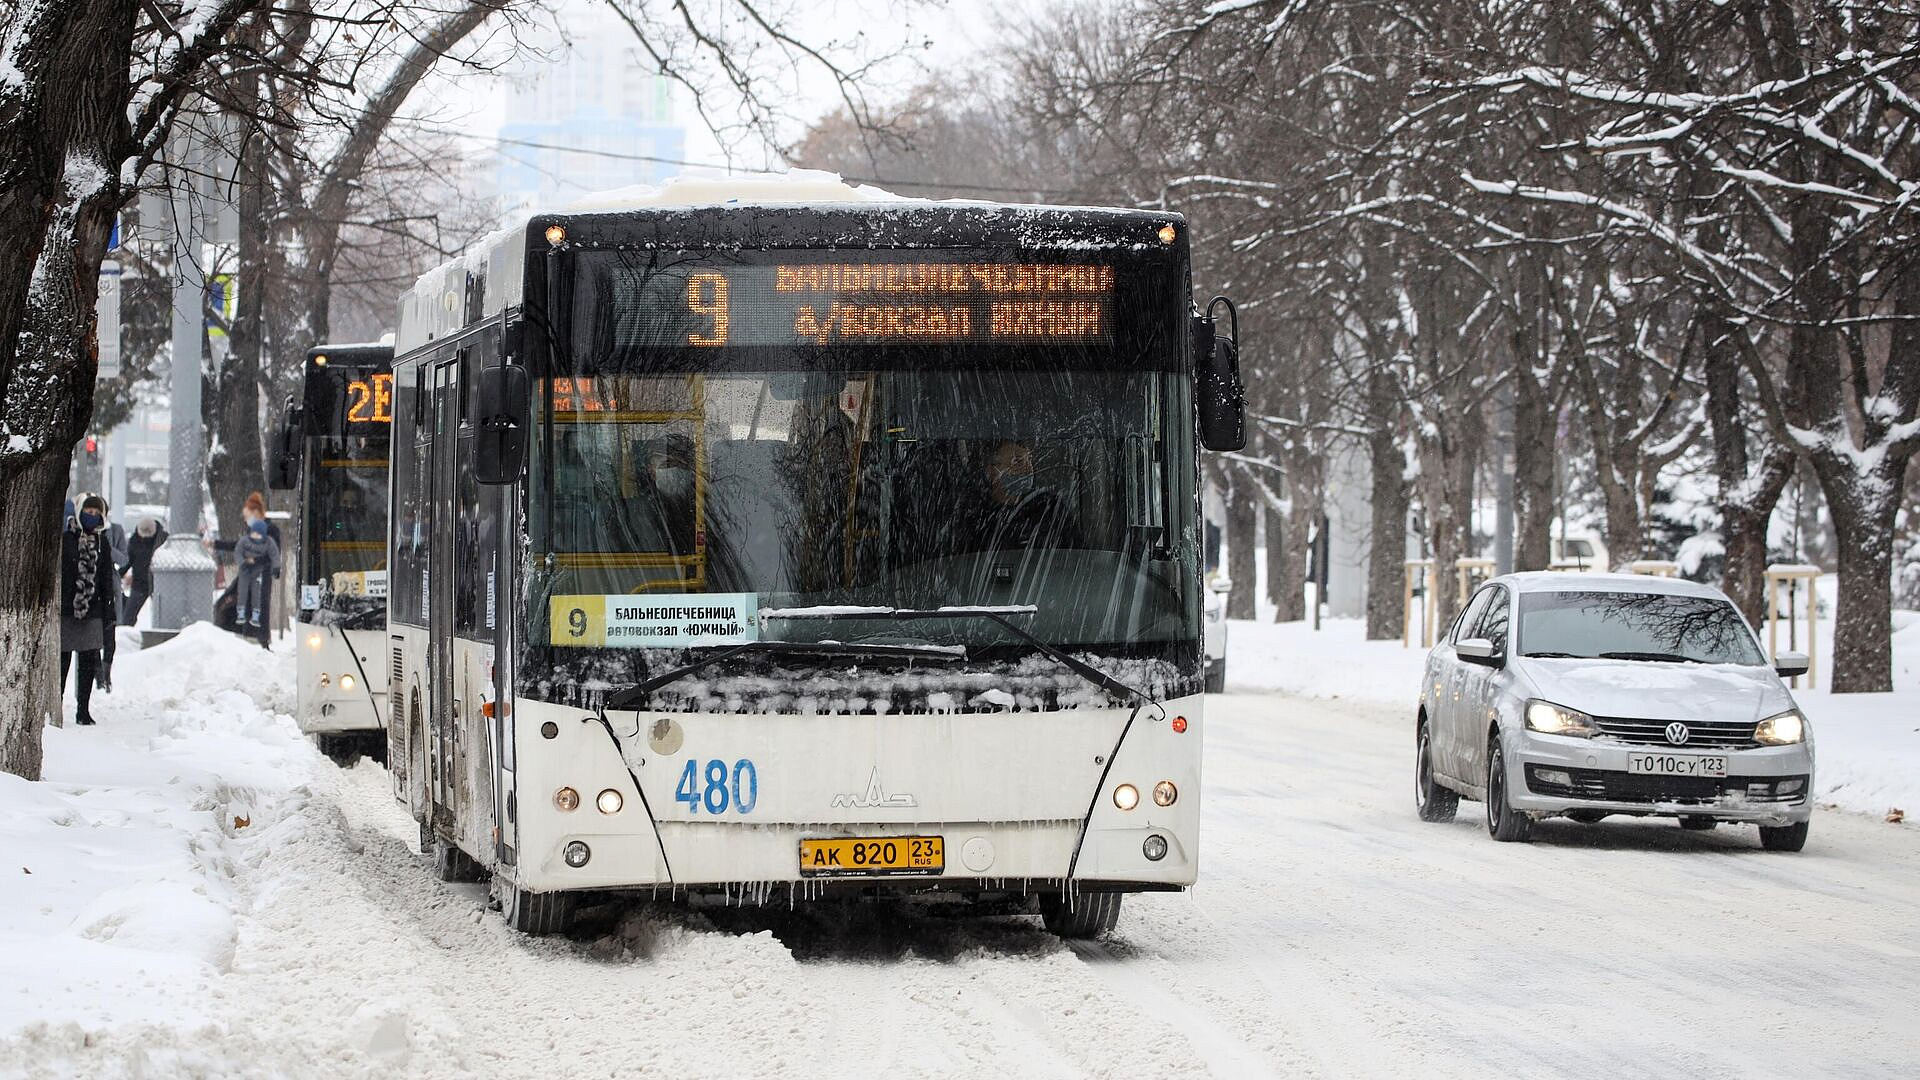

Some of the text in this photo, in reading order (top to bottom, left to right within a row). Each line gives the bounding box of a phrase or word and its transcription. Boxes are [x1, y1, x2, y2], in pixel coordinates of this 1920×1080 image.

[688, 273, 729, 346] 9
[568, 608, 588, 637] 9
[615, 607, 736, 621] БАЛЬНЕОЛЕЧЕБНИЦА
[682, 621, 745, 636] «ЮЖНЫЙ»
[1700, 758, 1723, 770] 123
[675, 758, 758, 815] 480
[813, 840, 934, 865] АК 820 23
